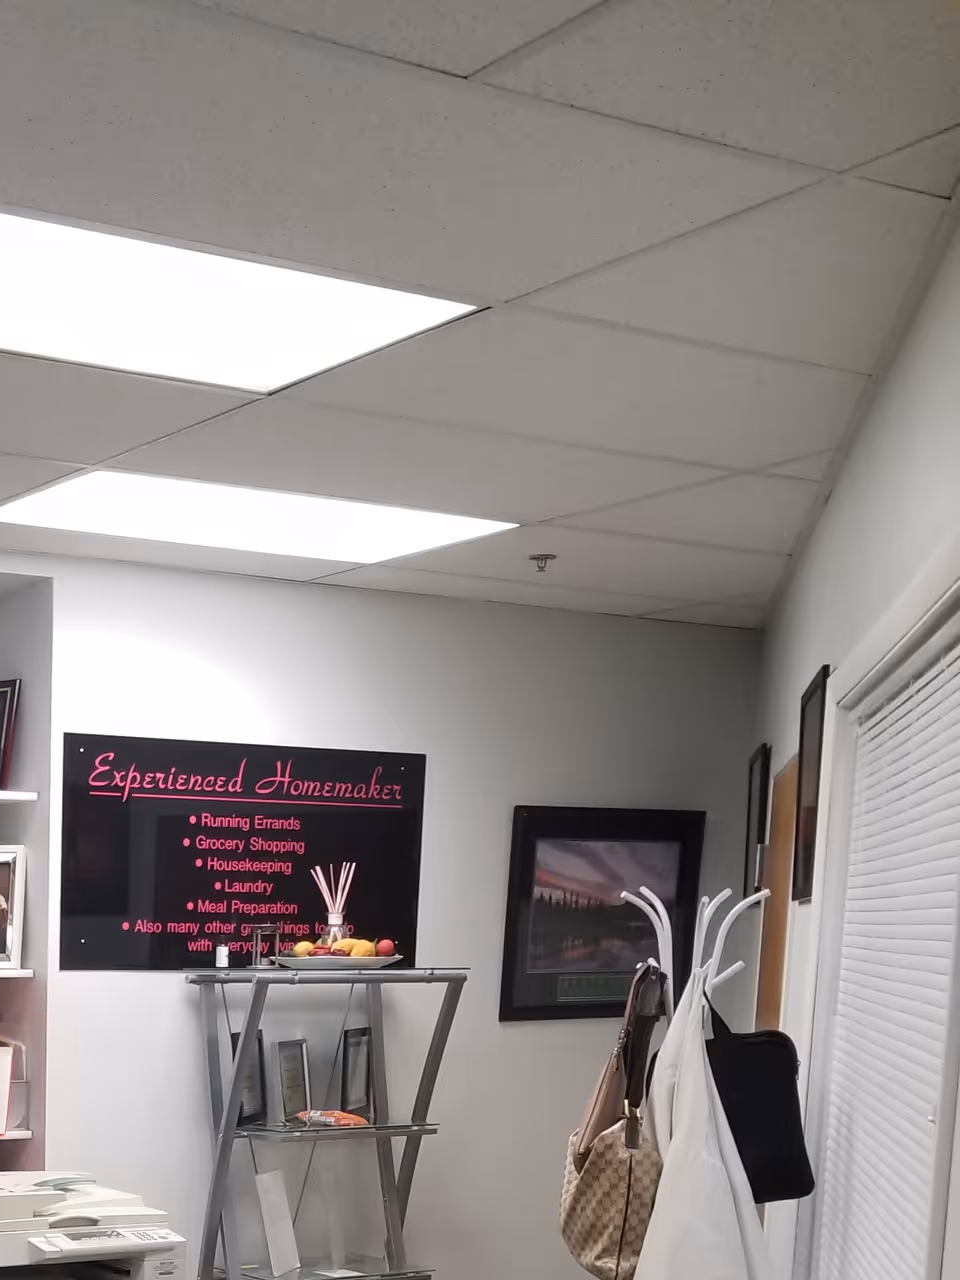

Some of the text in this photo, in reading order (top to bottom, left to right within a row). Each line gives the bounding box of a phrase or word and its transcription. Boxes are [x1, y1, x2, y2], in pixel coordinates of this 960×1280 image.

[88, 752, 403, 803] Experienced Homemaker
[201, 813, 301, 831] Running Errands
[195, 835, 305, 855] Grocery Shopping
[207, 856, 292, 876] Housekeeping
[224, 879, 273, 896] Laundry
[198, 899, 298, 916] Meal Preparation
[134, 920, 162, 934] Also
[167, 922, 200, 936] many
[205, 920, 236, 934] other
[188, 939, 212, 951] with
